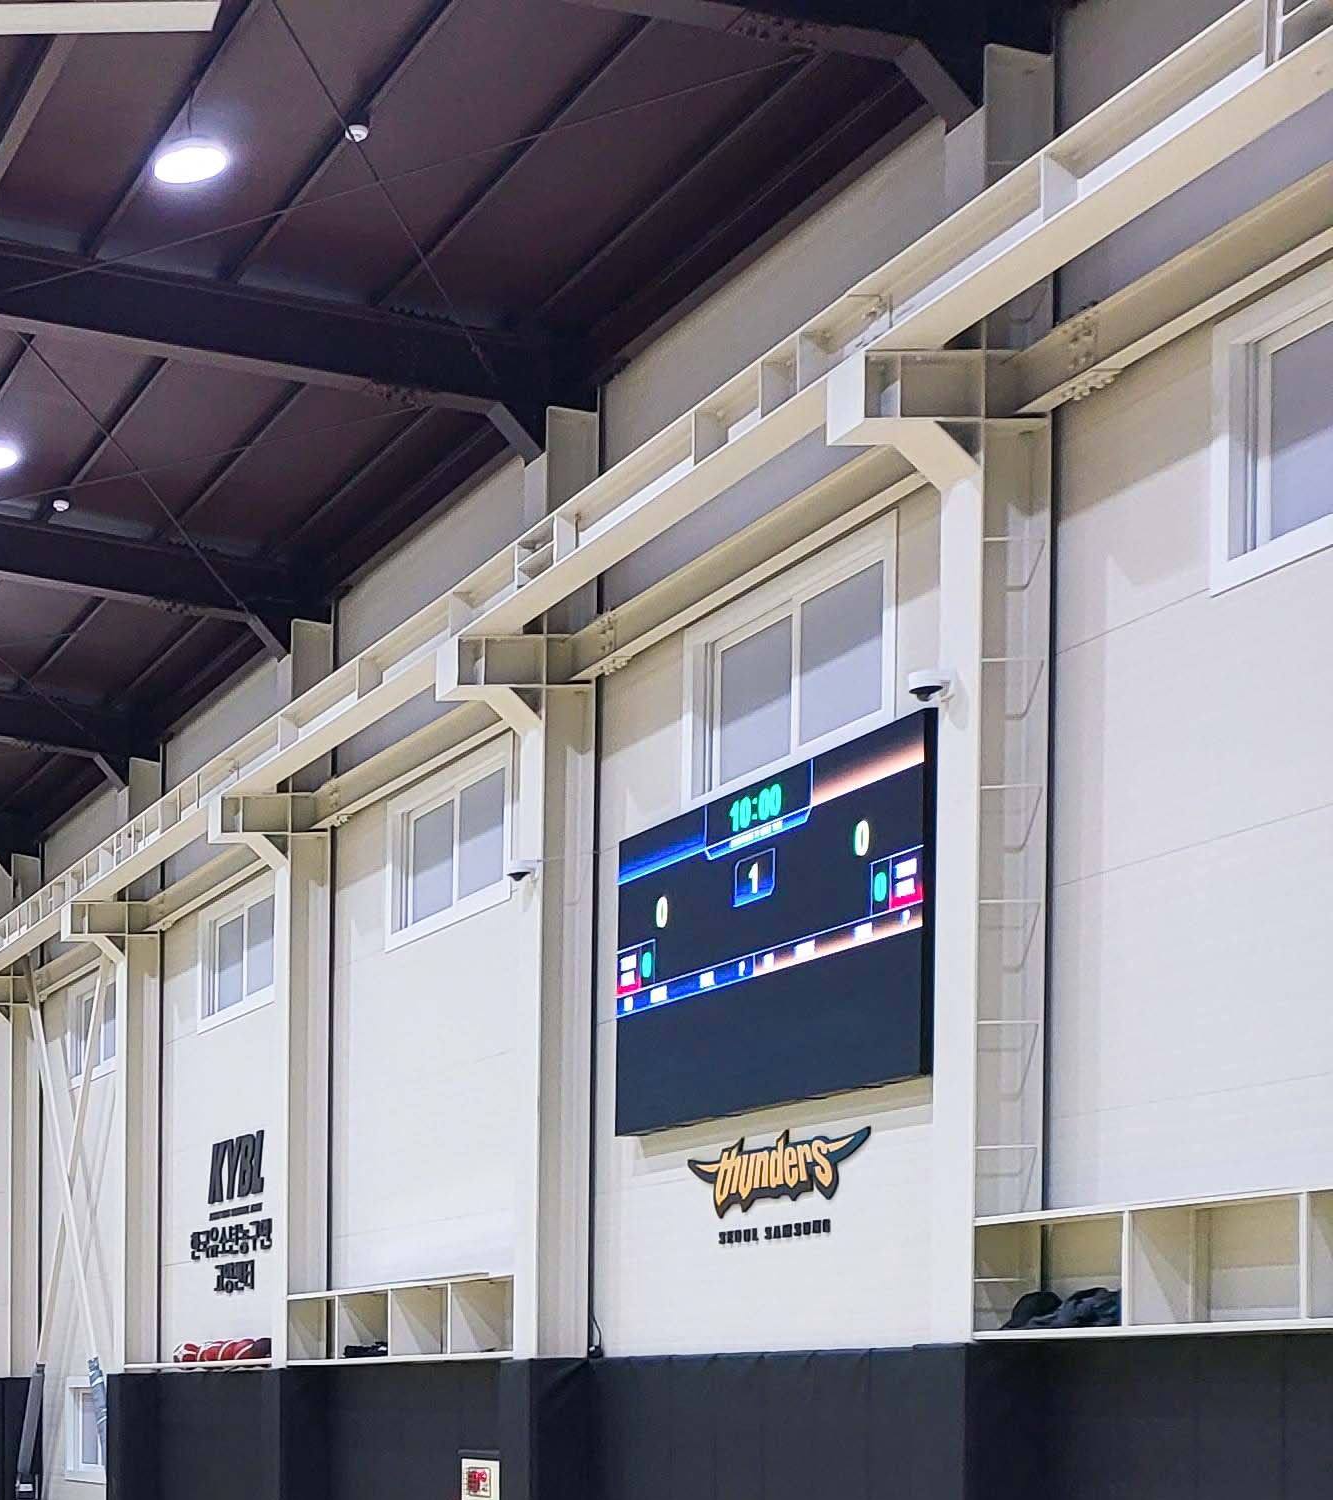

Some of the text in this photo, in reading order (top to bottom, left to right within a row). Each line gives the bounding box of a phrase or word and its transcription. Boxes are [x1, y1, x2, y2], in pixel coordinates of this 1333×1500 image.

[729, 783, 782, 832] 10:00
[854, 820, 870, 856] 0
[748, 862, 759, 894] 1
[655, 895, 669, 929] 0
[207, 1130, 264, 1204] KYBL
[718, 1218, 831, 1245] SEOUL SAMSUNG
